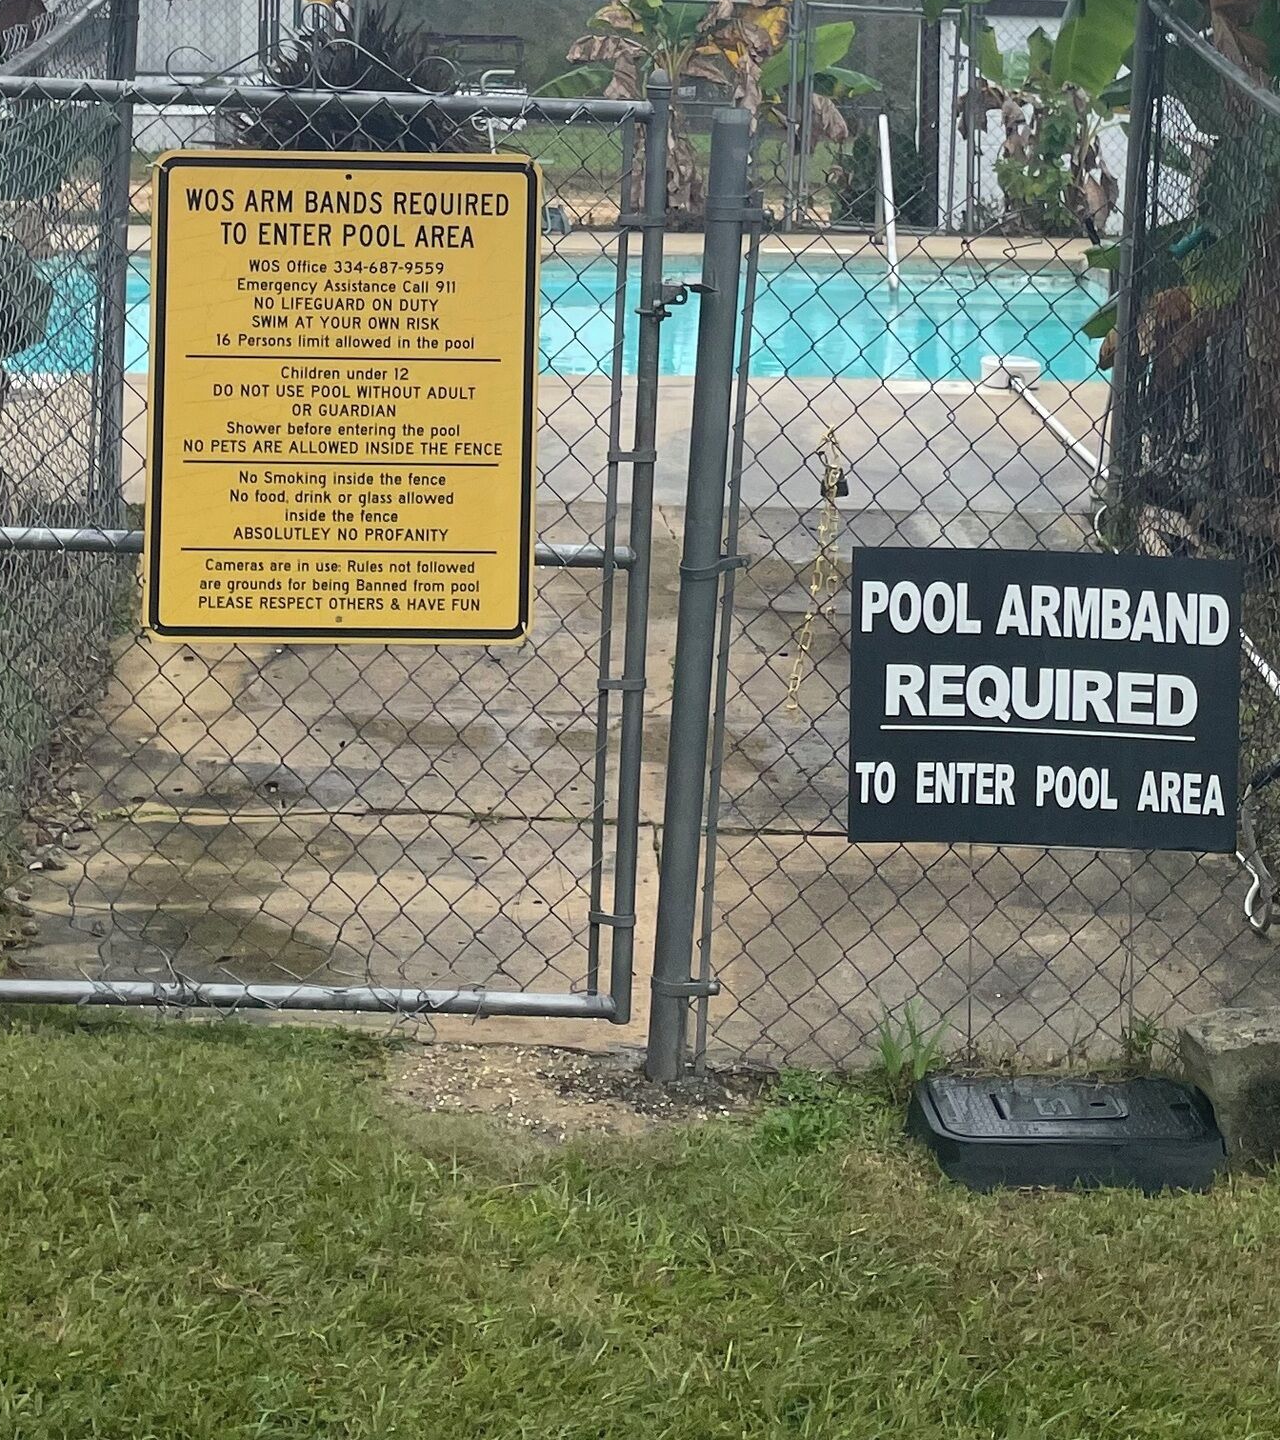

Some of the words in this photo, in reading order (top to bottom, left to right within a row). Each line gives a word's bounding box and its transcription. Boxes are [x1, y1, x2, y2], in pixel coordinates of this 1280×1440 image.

[185, 187, 235, 212] WOS
[244, 189, 294, 214] ARM
[304, 190, 383, 215] BANDS
[393, 191, 509, 217] REQUIRED
[220, 221, 247, 245] TO
[258, 222, 332, 247] ENTER
[342, 223, 406, 248] POOL
[414, 224, 475, 249] AREA
[248, 258, 281, 273] WOS
[286, 259, 328, 274] Office
[333, 260, 445, 275] 334-687-9559
[237, 277, 318, 296] Emergency
[323, 278, 397, 293] Assistance
[402, 279, 429, 294] Call
[435, 280, 456, 294] 911
[254, 296, 275, 310] NO
[281, 296, 366, 312] LIFEGUARD
[372, 297, 393, 312] ON
[399, 298, 439, 313] DUTY
[251, 314, 289, 329] SWIM
[294, 315, 315, 330] AT
[319, 315, 362, 330] YOUR
[367, 316, 400, 330] OWN
[406, 317, 440, 331] RISK
[216, 332, 231, 347] 16
[237, 333, 292, 348] Persons
[298, 334, 330, 348] limit
[335, 334, 392, 349] allowed
[397, 335, 411, 349] in
[416, 335, 439, 350] the
[444, 336, 475, 353] pool
[280, 365, 341, 380] Children
[346, 367, 388, 381] under
[394, 367, 409, 381] 12
[213, 383, 234, 397] DO
[240, 383, 271, 398] NOT
[275, 384, 305, 398] USE
[310, 384, 351, 399] POOL
[356, 384, 422, 400] WITHOUT
[426, 385, 477, 401] ADULT
[291, 403, 312, 417] OR
[318, 403, 397, 418] GUARDIAN
[226, 420, 282, 435] Shower
[287, 421, 332, 436] before
[337, 422, 396, 441] entering
[401, 423, 425, 437] the
[430, 423, 460, 440] pool
[183, 438, 204, 453] NO
[210, 439, 247, 453] PETS
[252, 439, 283, 454] ARE
[288, 440, 359, 455] ALLOWED
[365, 441, 415, 456] INSIDE
[419, 441, 449, 456] THE
[454, 442, 503, 457] FENCE
[239, 470, 258, 484] No
[263, 470, 327, 489] Smoking
[332, 471, 374, 486] inside
[379, 472, 403, 486] the
[407, 472, 446, 486] fence
[229, 488, 249, 503] No
[294, 489, 332, 504] drink
[337, 493, 353, 504] or
[358, 490, 393, 509] glass
[398, 491, 454, 505] allowed
[284, 507, 326, 522] inside
[331, 509, 355, 523] the
[359, 508, 399, 523] fence
[232, 526, 331, 541] ABSOLUTLEY
[337, 527, 358, 542] NO
[364, 527, 449, 542] PROFANITY
[205, 557, 265, 572] Cameras
[269, 561, 292, 572] are
[297, 559, 310, 572] in
[347, 559, 384, 573] Rules
[389, 560, 412, 574] not
[416, 560, 476, 574] followed
[199, 579, 222, 590] are
[226, 577, 283, 595] grounds
[287, 577, 307, 592] for
[311, 578, 350, 596] being
[356, 578, 408, 592] Banned
[413, 578, 445, 593] from
[450, 579, 480, 596] pool
[198, 595, 254, 610] PLEASE
[259, 596, 324, 610] RESPECT
[328, 597, 385, 611] OTHERS
[390, 597, 401, 611] &
[406, 597, 446, 612] HAVE
[451, 598, 481, 612] FUN
[861, 580, 982, 634] POOL
[995, 583, 1230, 646] ARMBAND
[885, 663, 1198, 727] REQUIRED
[855, 761, 896, 804] TO
[916, 761, 1016, 806] ENTER
[1035, 765, 1118, 810] POOL
[1137, 770, 1225, 816] AREA
